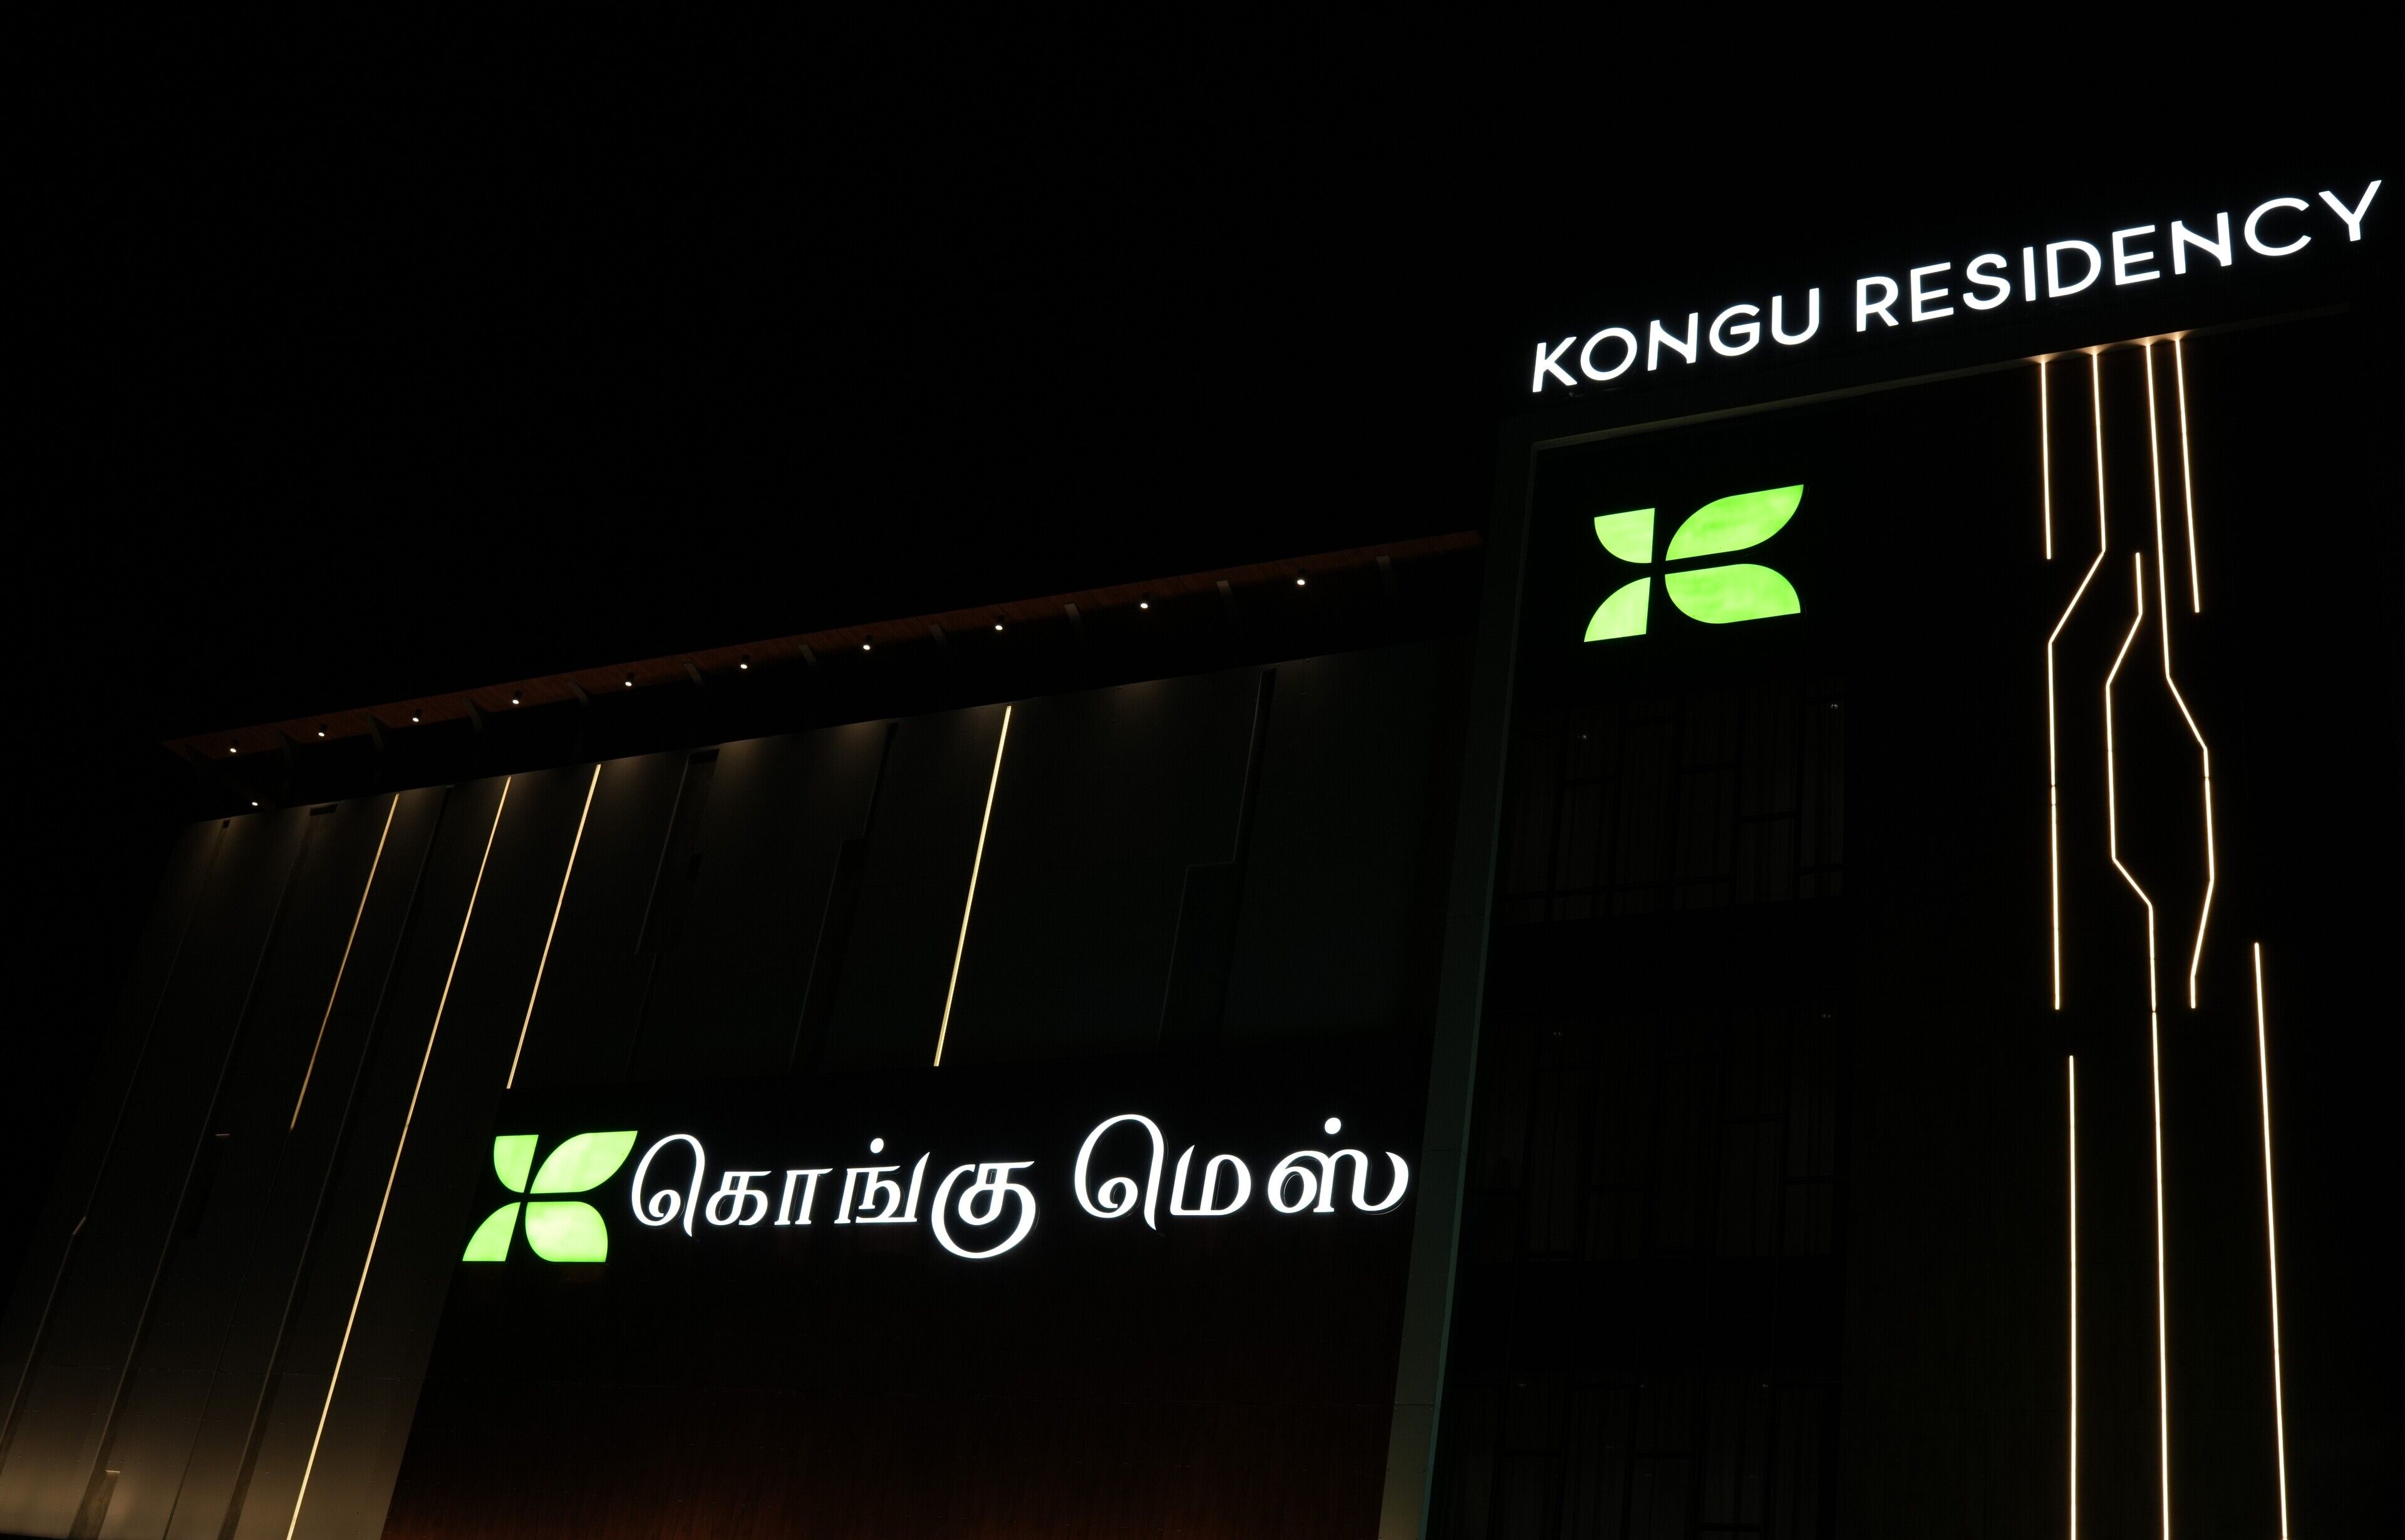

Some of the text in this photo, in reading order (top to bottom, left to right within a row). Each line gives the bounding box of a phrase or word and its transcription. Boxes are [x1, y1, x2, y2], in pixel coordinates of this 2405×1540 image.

[1532, 180, 2382, 393] KONGU RESIDENCY
[631, 1114, 1409, 1259] கொங்கு மெஸ்
